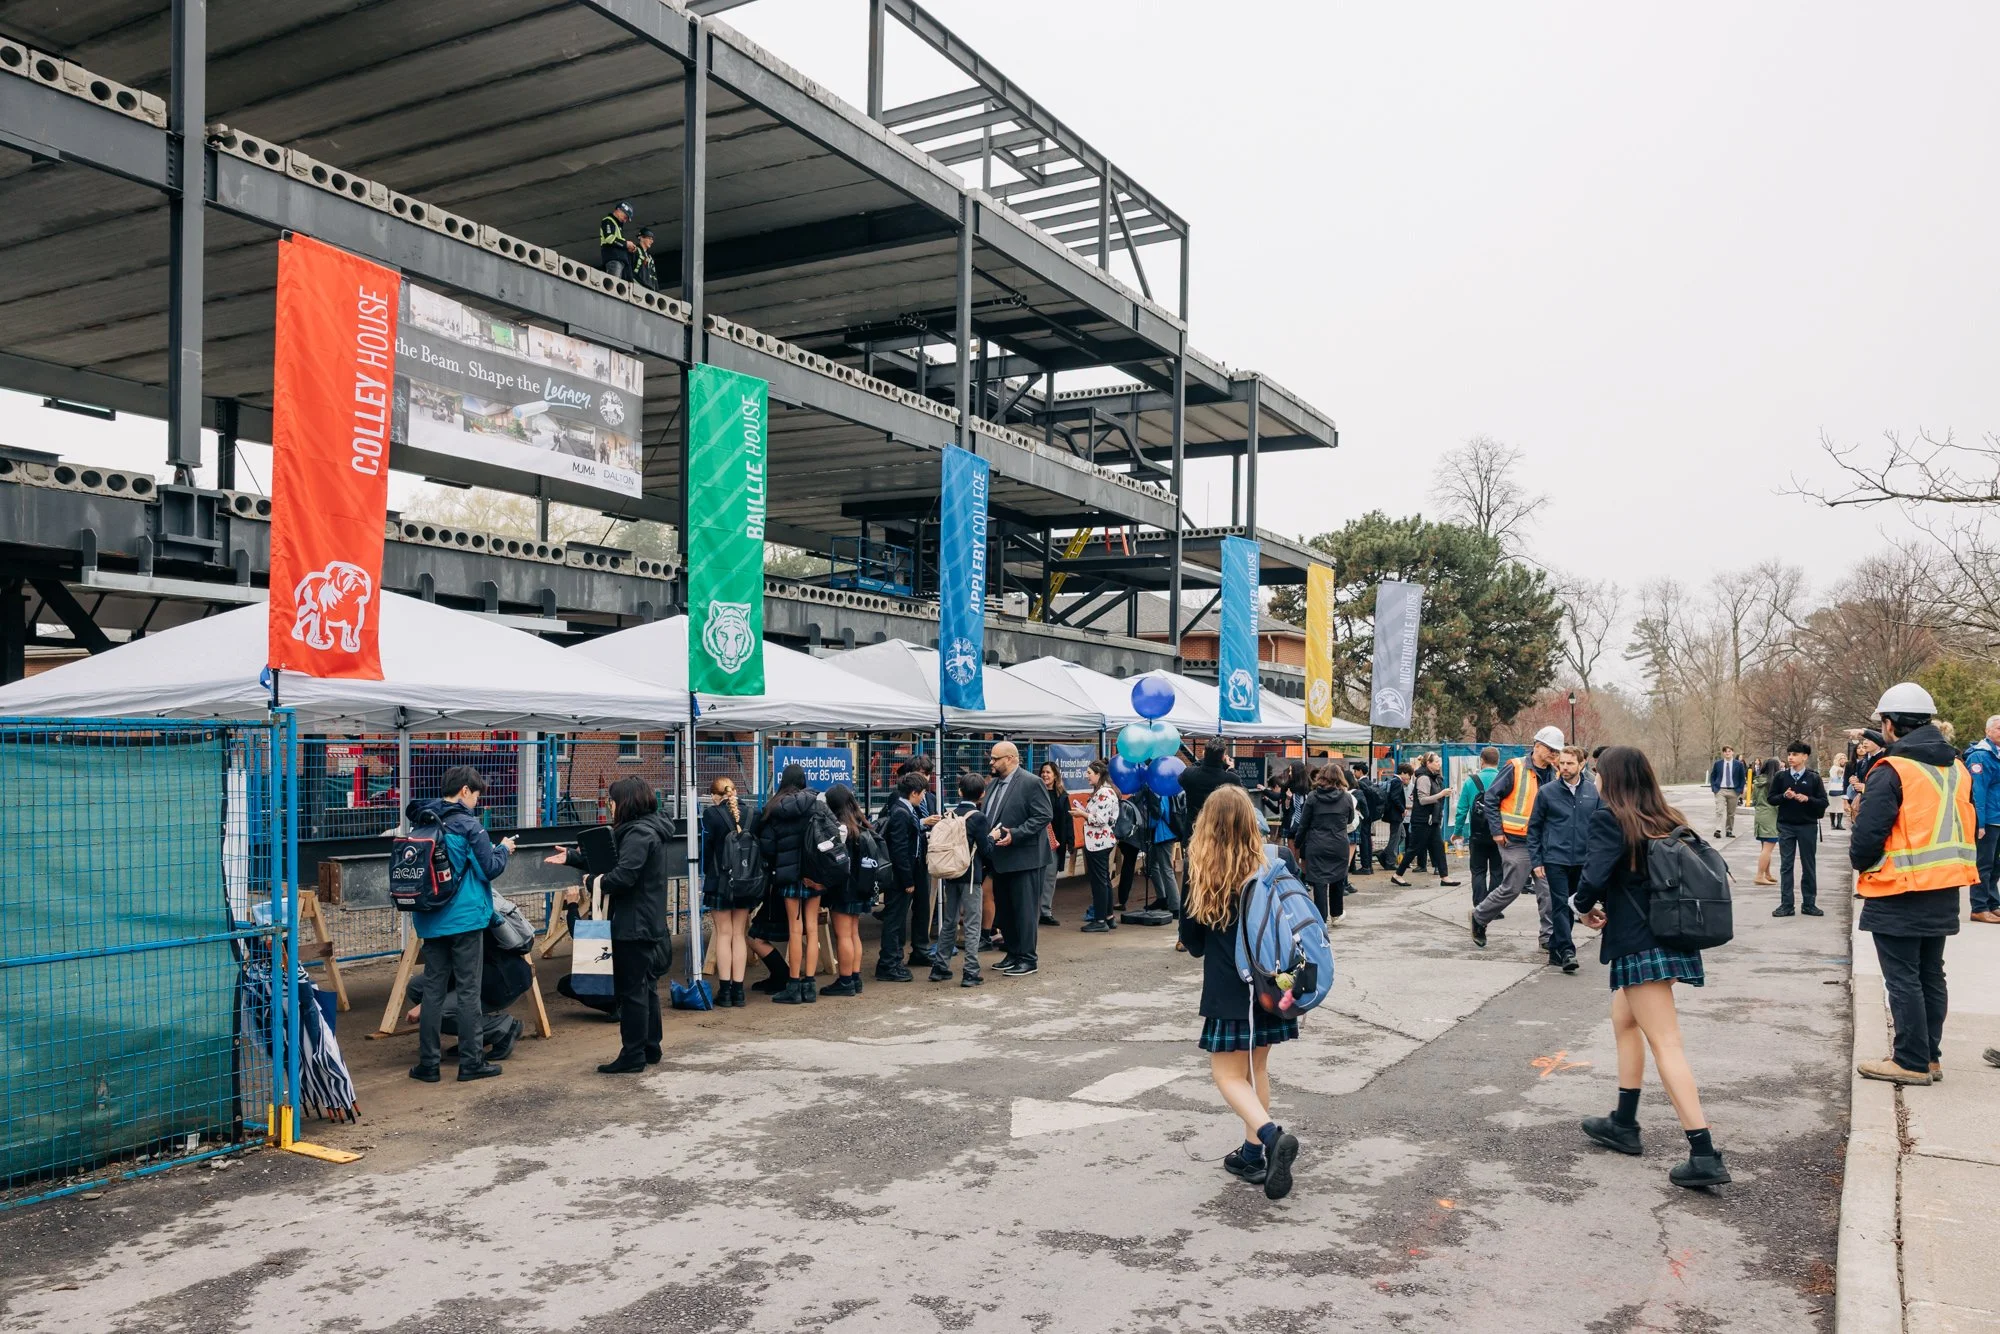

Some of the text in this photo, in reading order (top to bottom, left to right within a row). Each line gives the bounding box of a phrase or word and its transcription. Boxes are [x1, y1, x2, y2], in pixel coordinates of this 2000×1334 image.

[352, 285, 389, 476] COLLEY HOUSE
[395, 337, 418, 359] the
[421, 345, 464, 375] Beam.
[468, 360, 514, 390] Shape
[517, 375, 541, 394] the
[572, 461, 596, 477] MJMA
[603, 468, 635, 486] DALTON
[742, 394, 765, 540] BAILLIE HOUSE
[970, 470, 986, 615] APPLEBY COLLEGE
[1247, 551, 1259, 636] WALKER HOUSE
[1400, 591, 1419, 684] NIGHTINGALE HOUSE
[782, 756, 790, 768] A
[819, 756, 846, 771] building
[807, 769, 819, 781] for
[820, 769, 830, 781] 85
[831, 772, 851, 783] years.
[392, 867, 425, 879] RCAF
